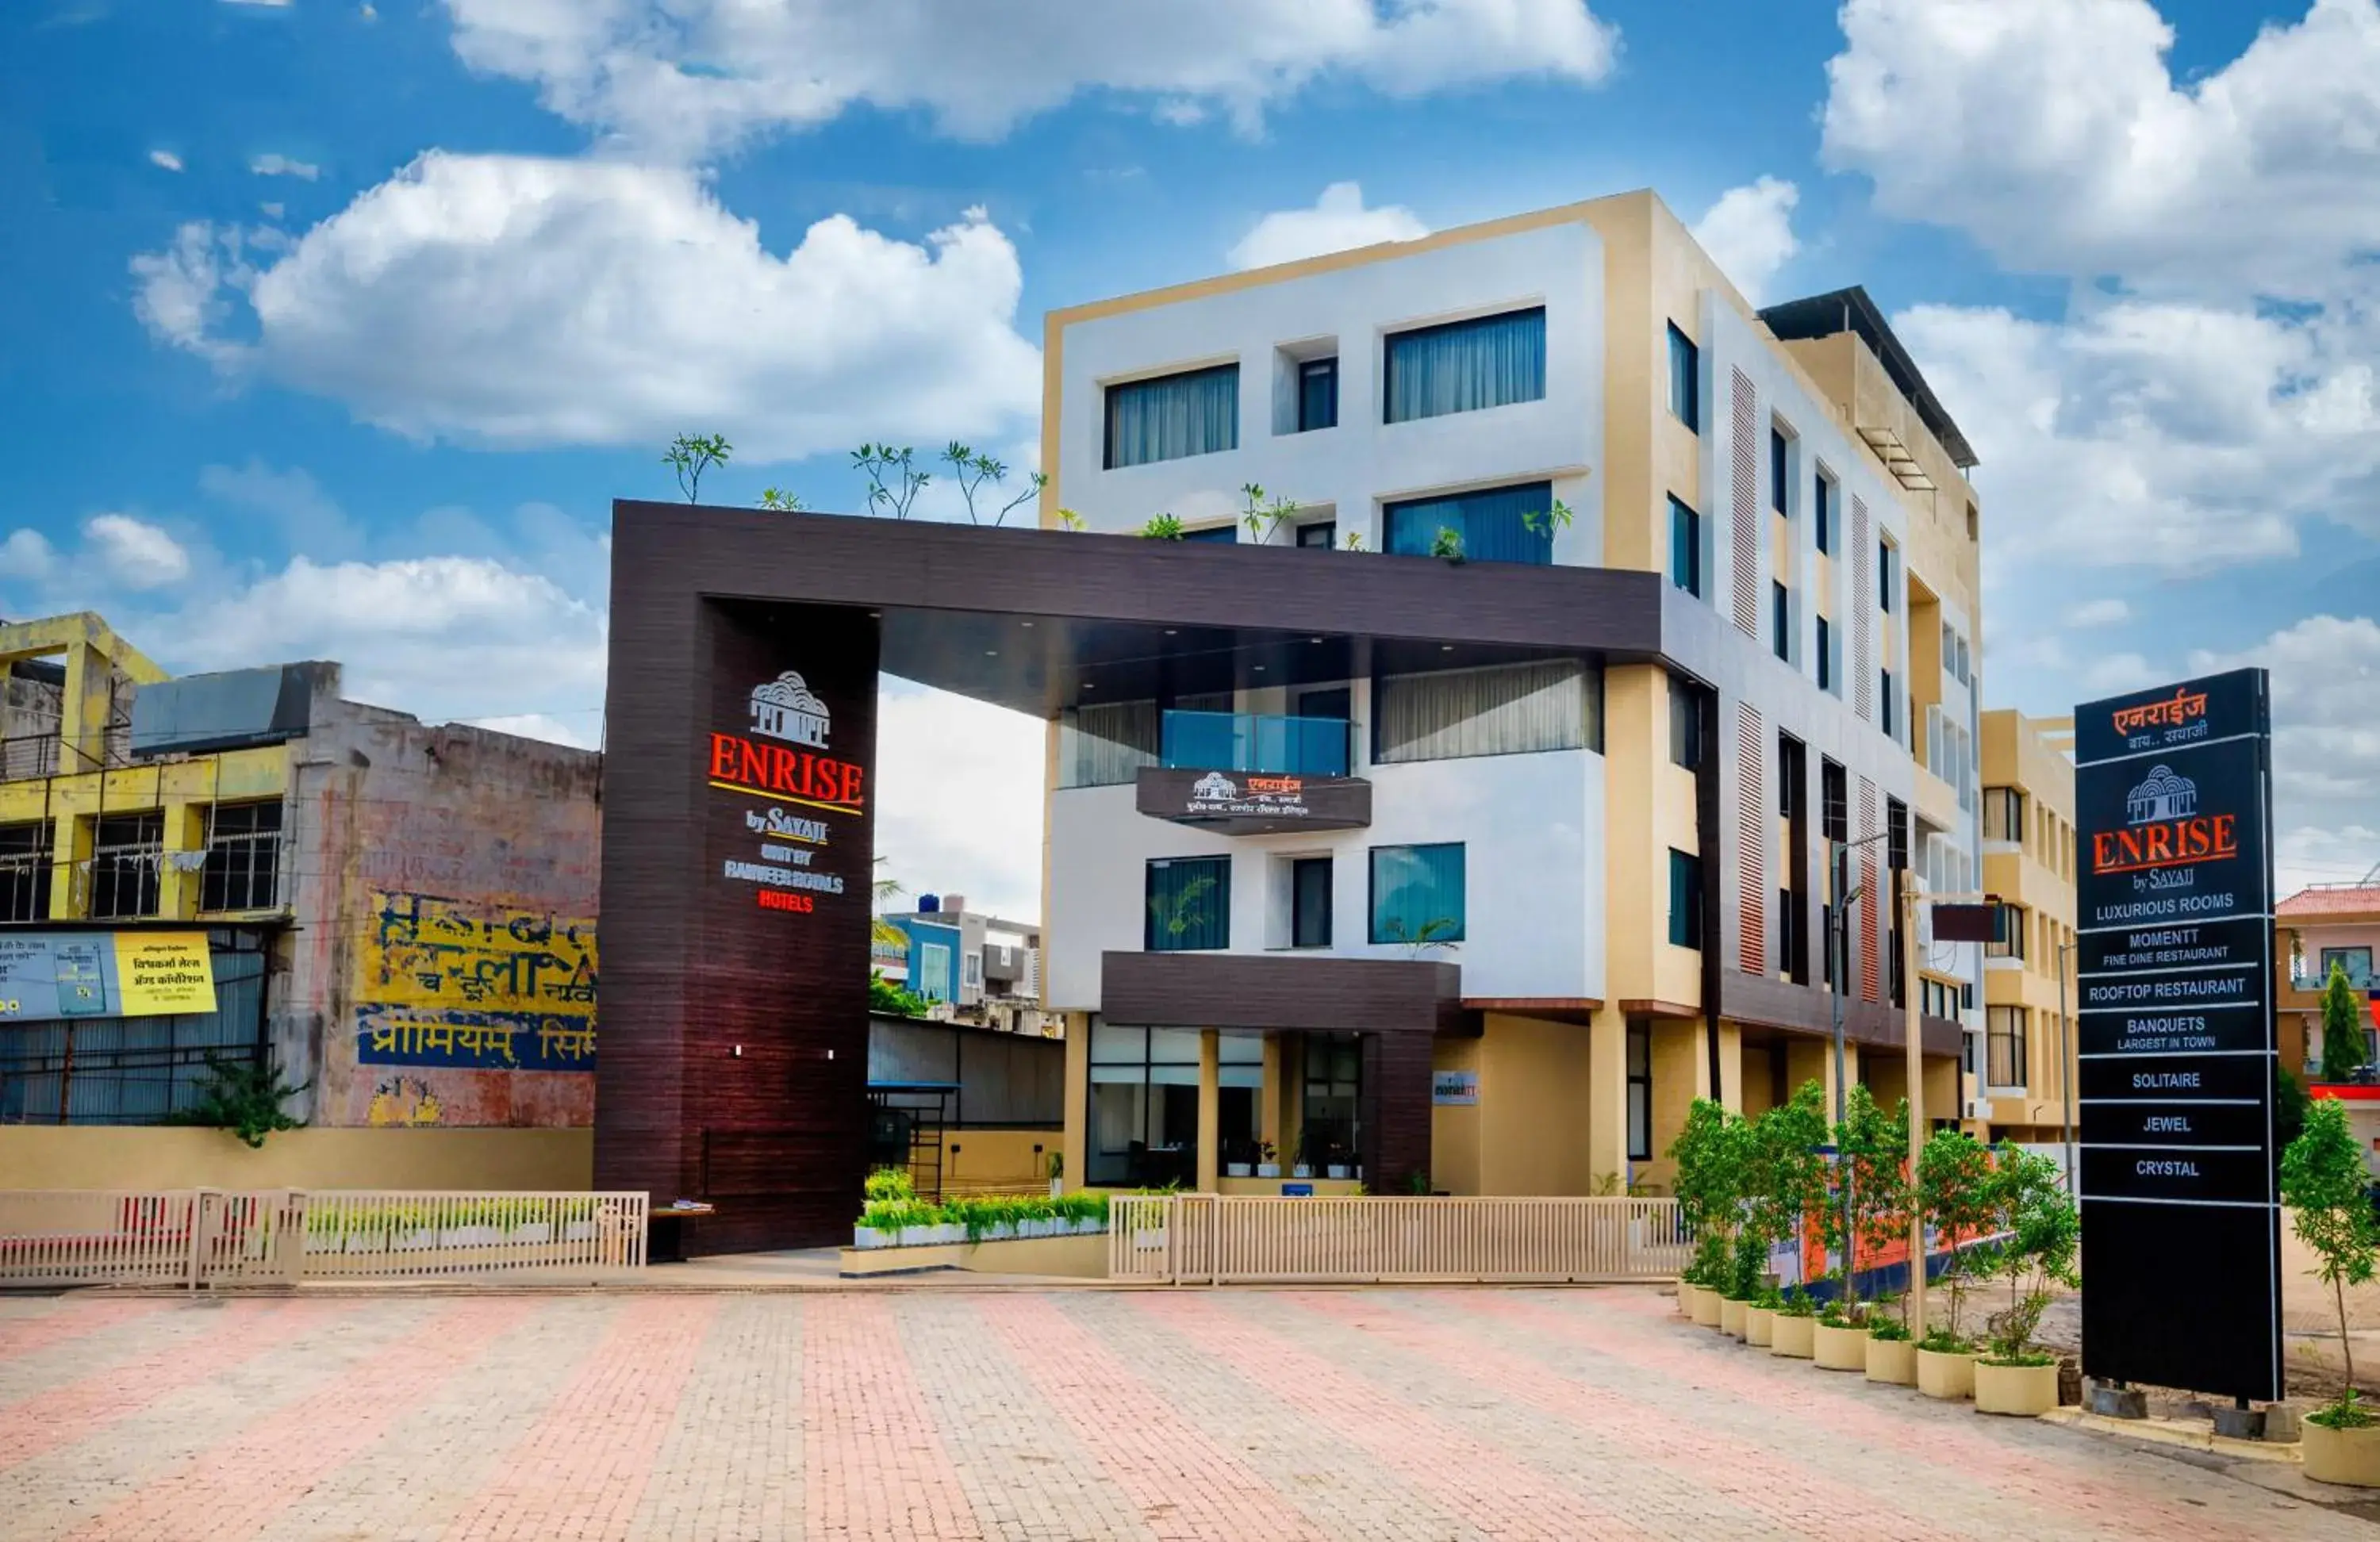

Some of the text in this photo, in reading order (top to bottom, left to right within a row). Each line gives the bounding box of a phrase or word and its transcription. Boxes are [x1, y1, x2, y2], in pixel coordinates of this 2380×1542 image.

[2112, 687, 2208, 736] एनराईज
[708, 732, 864, 806] ENRISE
[747, 810, 767, 833] by
[2093, 813, 2238, 867] ENRISE
[2133, 875, 2148, 892] by
[758, 888, 813, 913] HOTELS
[2097, 893, 2234, 921] LUXURIOUS ROOMS
[2129, 929, 2200, 948] MOMENTT
[2103, 946, 2228, 965] FINE DINE RESTAURANT
[2089, 978, 2246, 1001] ROOFTOP RESTAURANT
[2127, 1016, 2205, 1034] BANQUETS
[2117, 1036, 2217, 1050] LARGEST IN TOWN
[2132, 1073, 2201, 1088] SOLITAIRE
[2143, 1116, 2192, 1132] JEWEL
[2136, 1160, 2200, 1176] CRYSTAL
